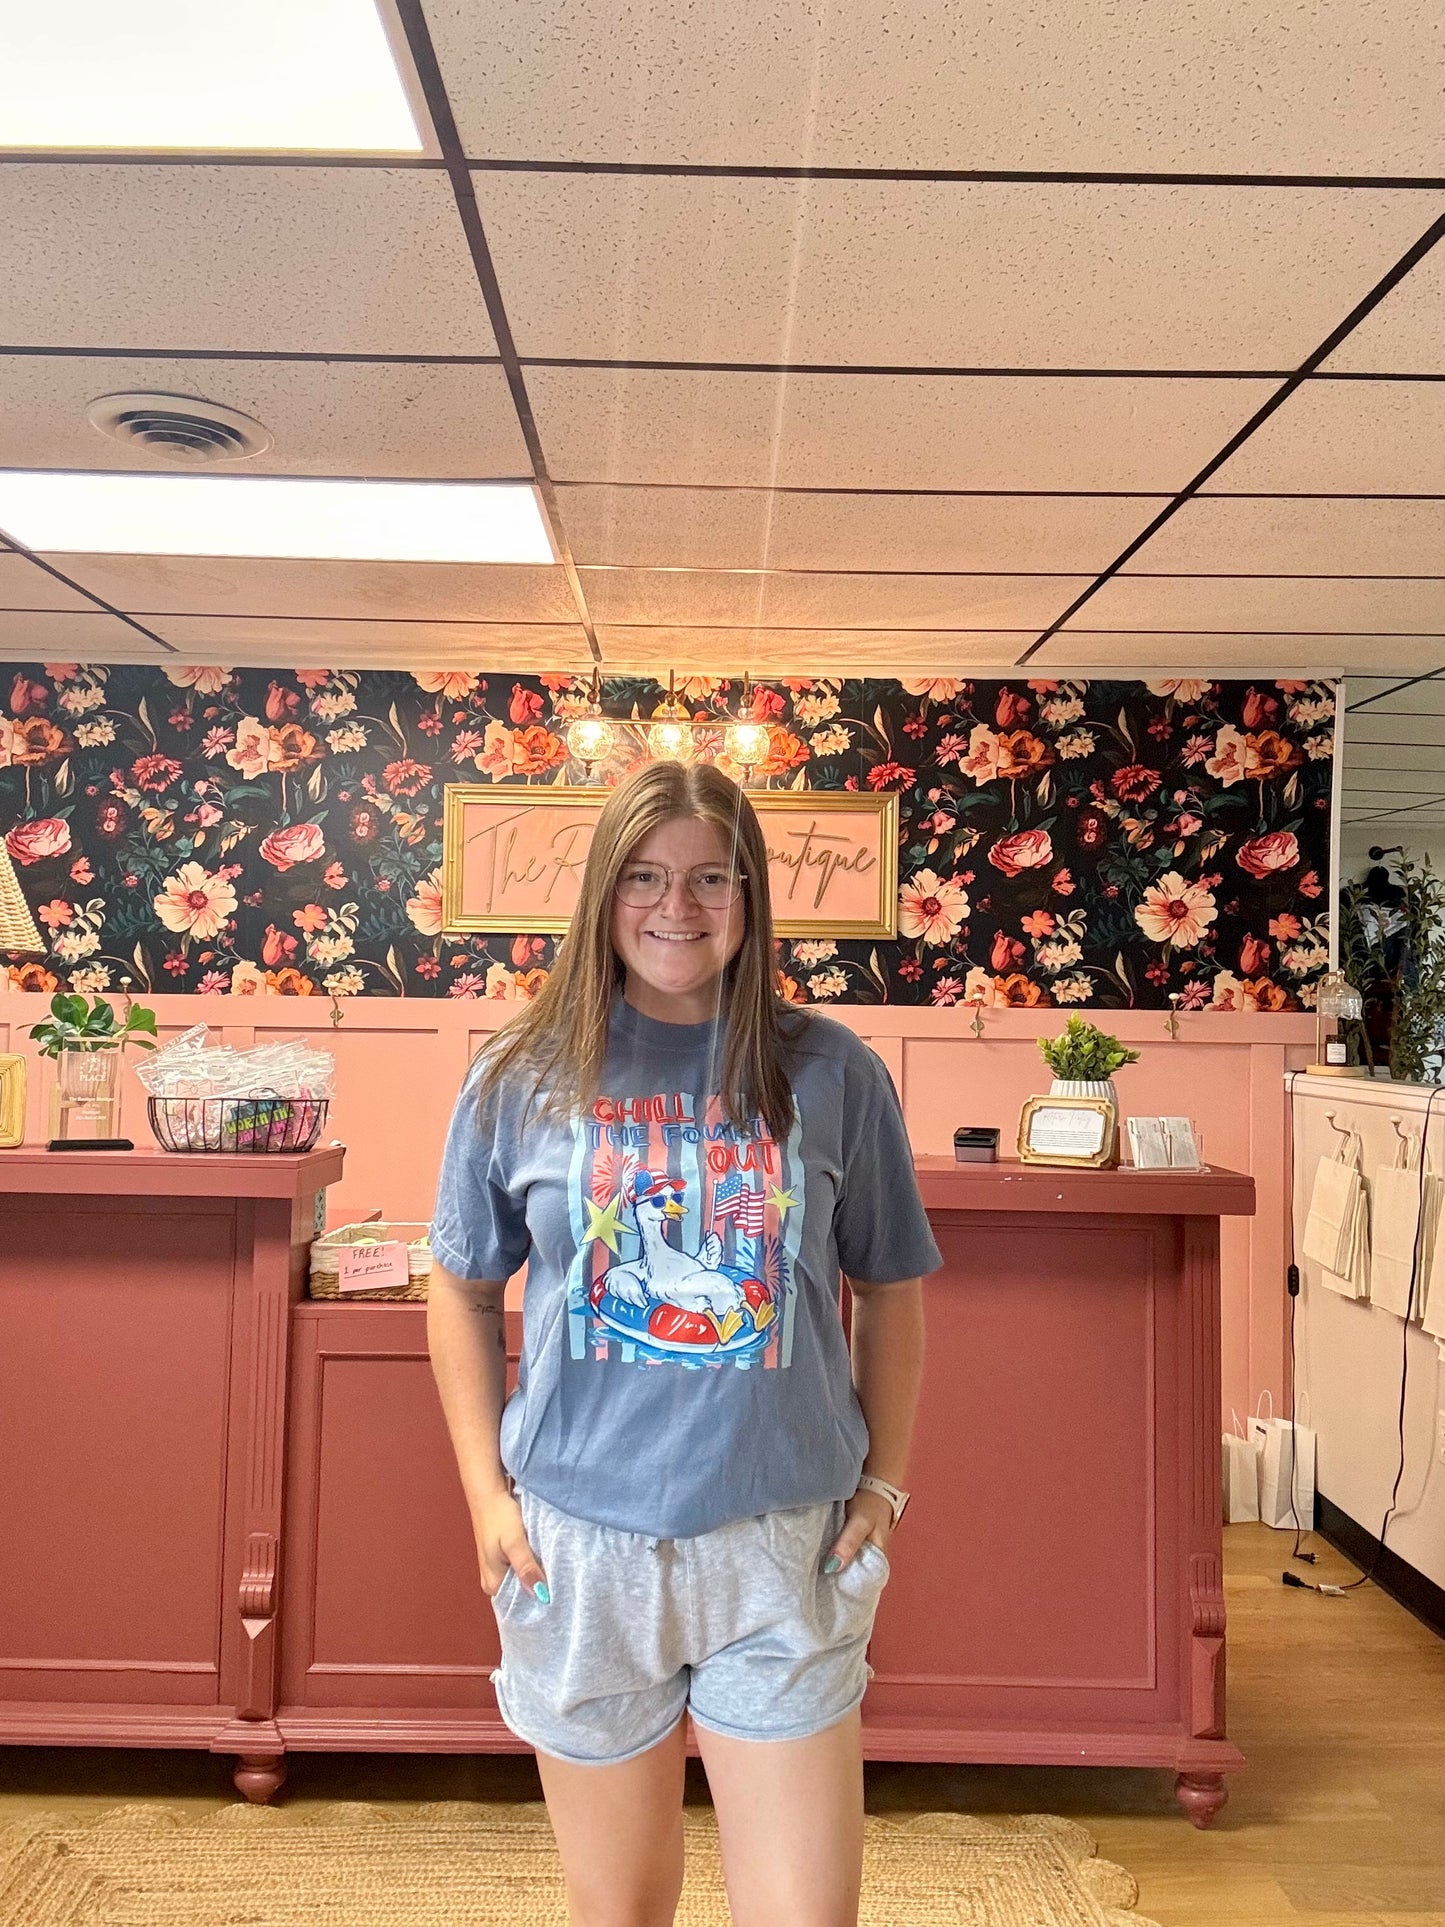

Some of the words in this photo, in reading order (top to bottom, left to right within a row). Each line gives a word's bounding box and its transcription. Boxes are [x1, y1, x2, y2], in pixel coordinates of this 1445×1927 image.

[466, 805, 547, 913] The
[766, 820, 877, 910] outique
[79, 1074, 107, 1082] PLACE
[225, 1113, 270, 1134] WORTH
[592, 1093, 695, 1125] CHILL
[586, 1120, 651, 1149] THE
[661, 1118, 779, 1147] FOUT
[707, 1141, 777, 1176] OUT
[352, 1246, 385, 1260] FREE!
